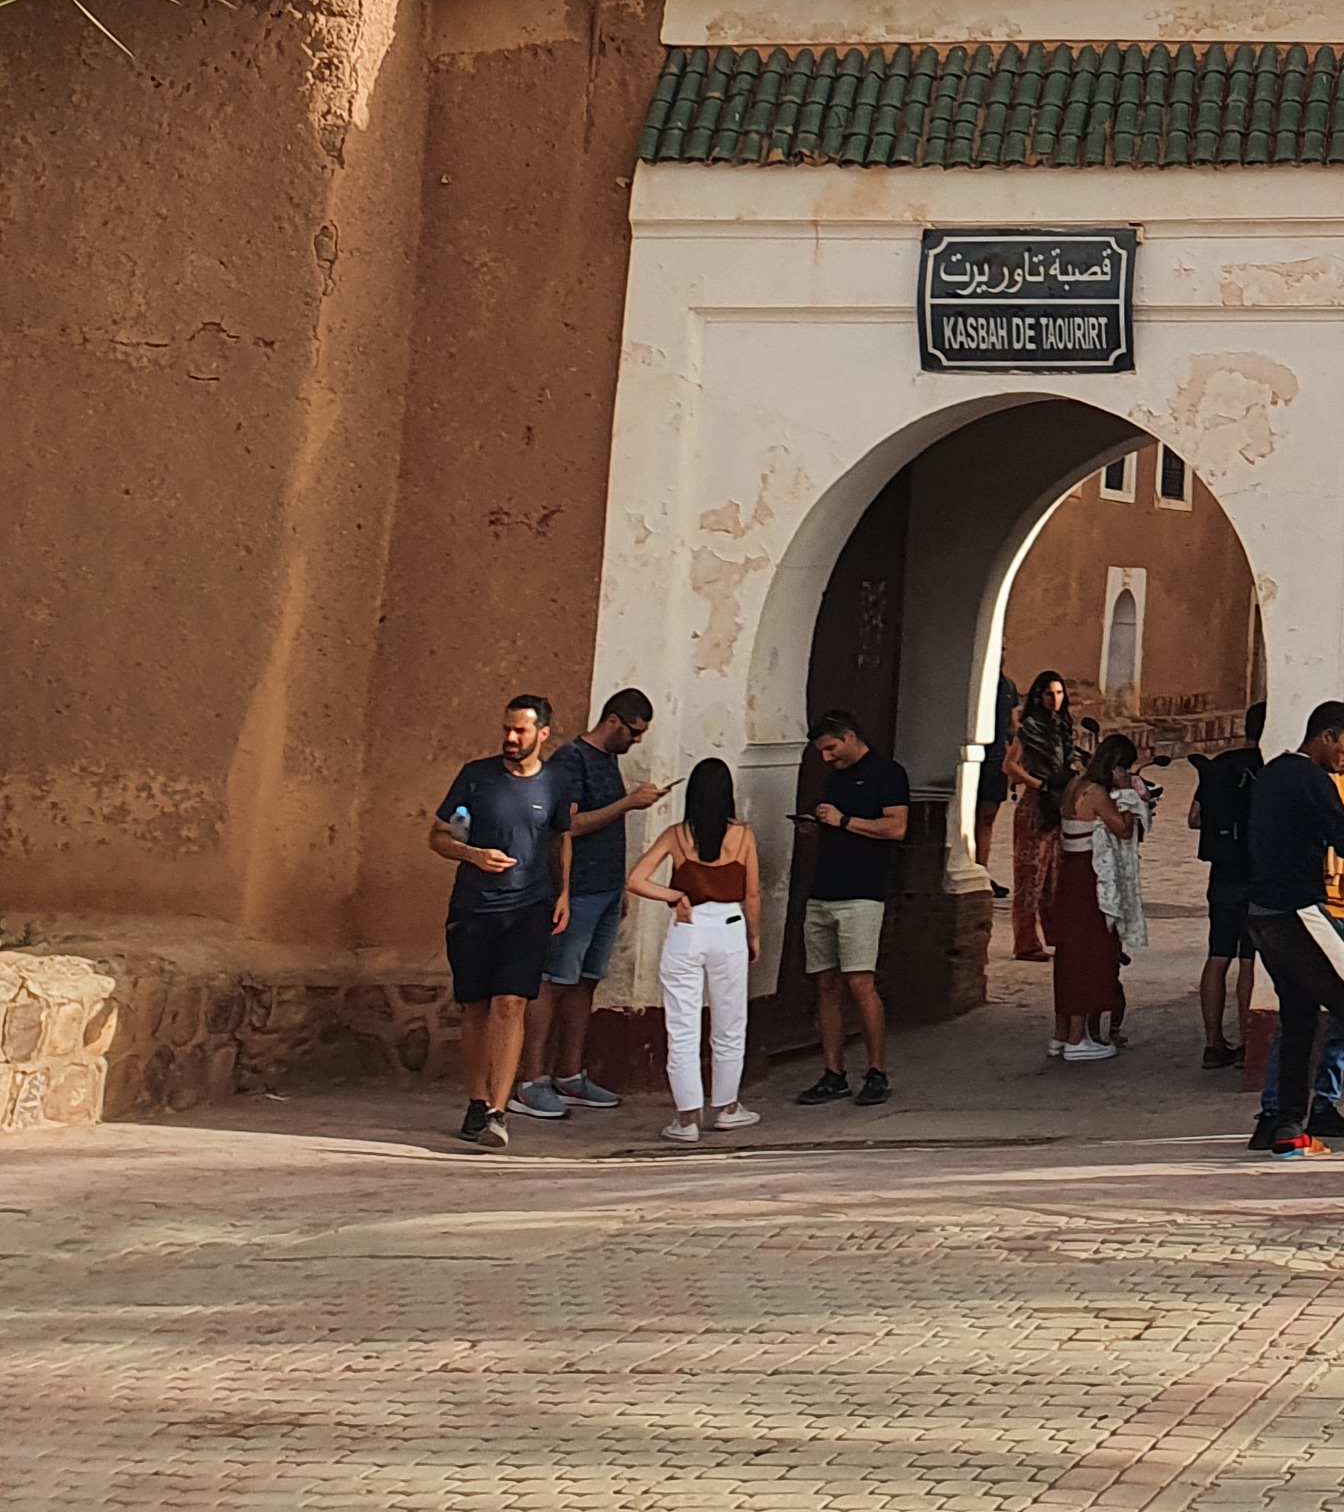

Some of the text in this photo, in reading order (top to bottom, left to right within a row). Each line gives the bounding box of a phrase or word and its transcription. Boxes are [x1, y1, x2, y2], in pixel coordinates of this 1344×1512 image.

[939, 248, 1111, 296] قصبة تاوريرت
[943, 316, 1108, 350] KASBAH DE TAOURIRT
